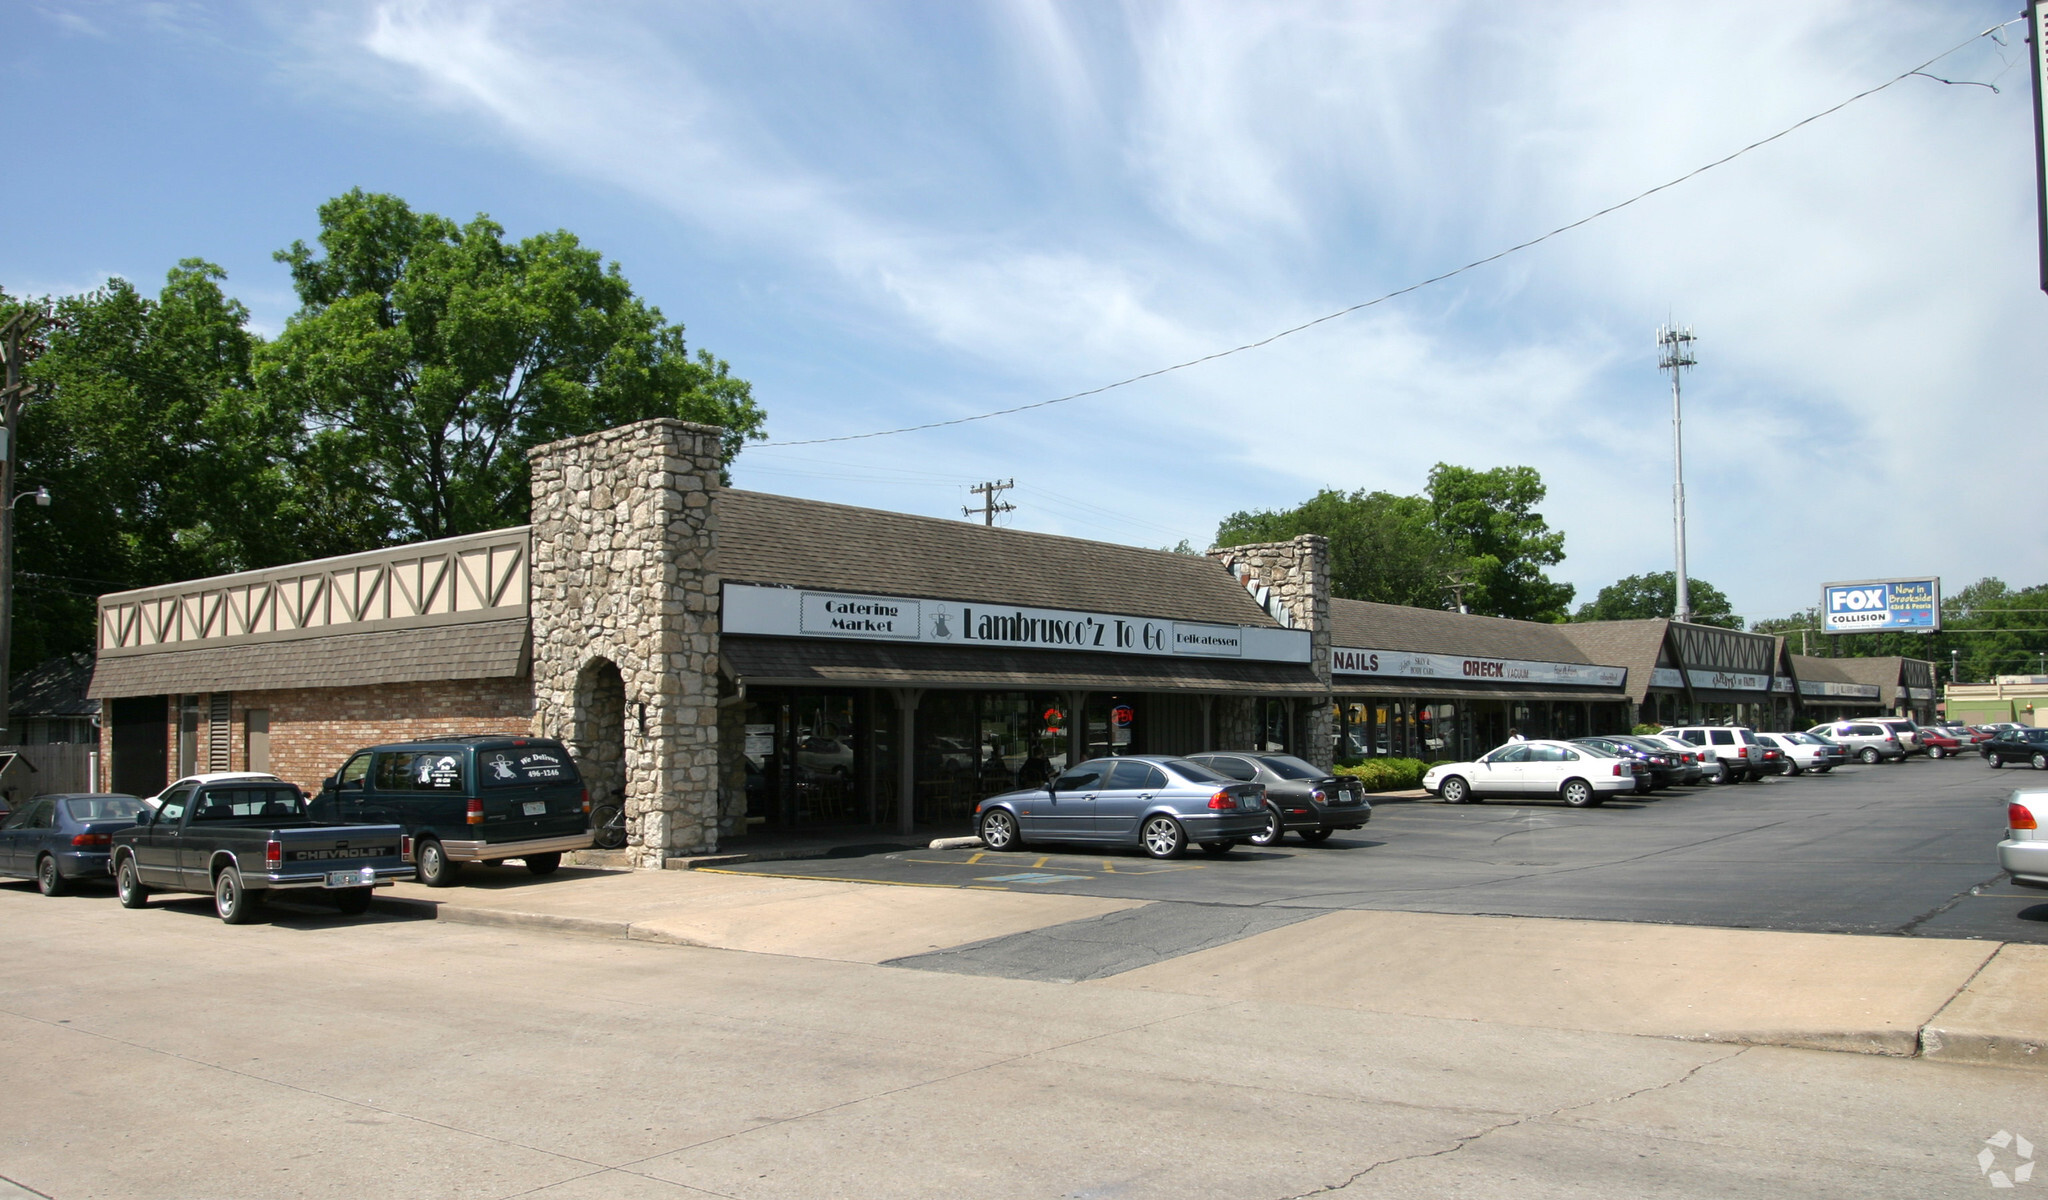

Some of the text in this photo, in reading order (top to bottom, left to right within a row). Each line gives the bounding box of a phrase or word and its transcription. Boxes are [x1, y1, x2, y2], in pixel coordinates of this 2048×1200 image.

[1895, 584, 1925, 594] Now in
[1832, 589, 1884, 611] FOX
[1889, 593, 1932, 603] Brookside
[825, 600, 898, 617] Catering
[1832, 613, 1886, 623] COLLISION
[830, 618, 894, 632] Market
[963, 608, 1166, 651] Lambrusco'z To Go
[1176, 633, 1238, 647] Delicatessen
[1333, 651, 1379, 672] NAILS
[1462, 660, 1504, 678] ORECK
[1506, 668, 1529, 680] VACUUM
[520, 754, 559, 765] We Deliver
[527, 769, 560, 778] 496-1246
[296, 847, 386, 860] CHEVROLET
